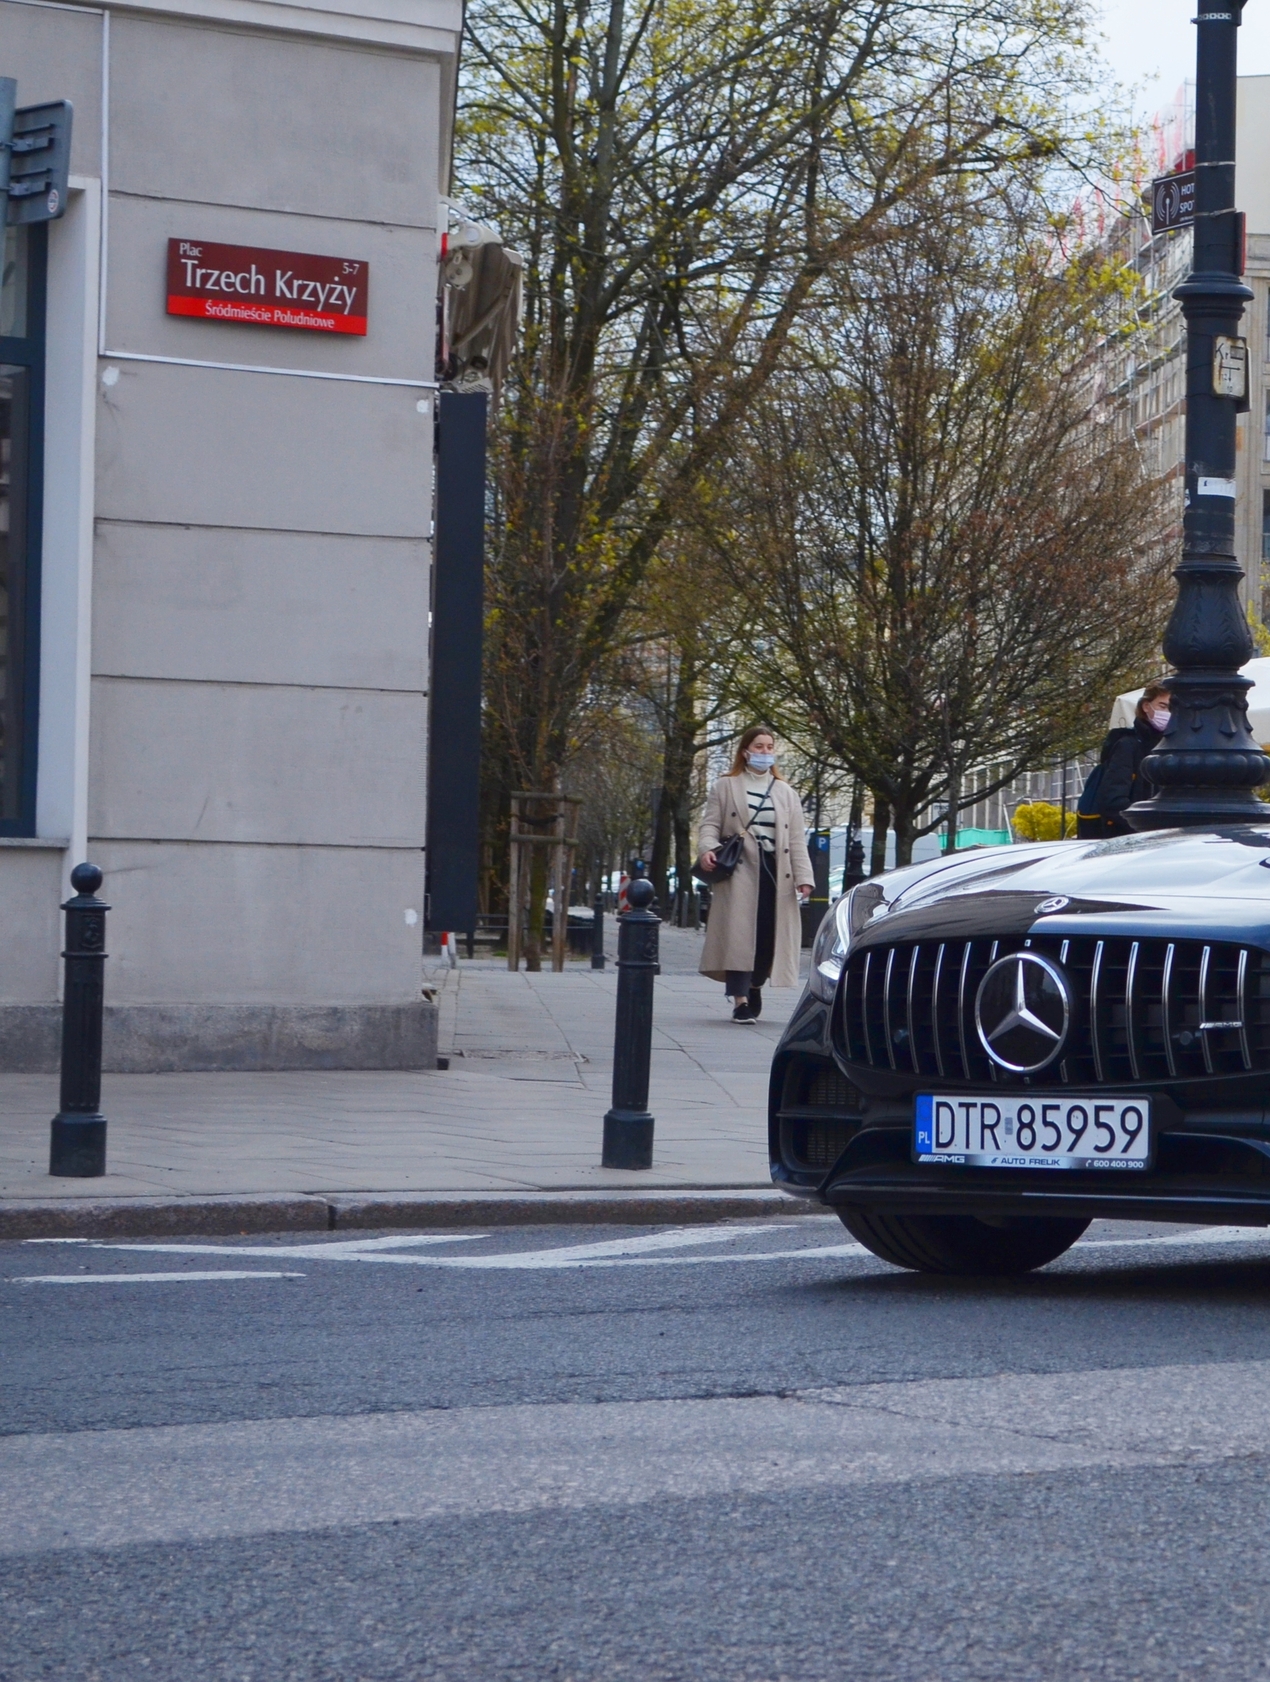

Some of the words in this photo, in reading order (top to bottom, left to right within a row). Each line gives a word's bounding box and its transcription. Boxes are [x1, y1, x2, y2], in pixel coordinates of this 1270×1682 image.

[1181, 183, 1195, 196] HOT
[180, 242, 202, 257] Plac
[342, 262, 360, 275] 5-7
[181, 259, 265, 295] Trzech
[275, 269, 357, 316] Krzyży
[205, 299, 271, 321] Śródmieście
[273, 310, 335, 329] Południowe
[818, 837, 827, 849] P
[935, 1101, 1002, 1150] DTR
[1016, 1103, 1144, 1154] 85959
[918, 1131, 930, 1144] PL
[1001, 1157, 1026, 1166] AUTO
[1093, 1160, 1110, 1168] 600
[1111, 1160, 1127, 1169] 400
[1128, 1161, 1144, 1169] 900
